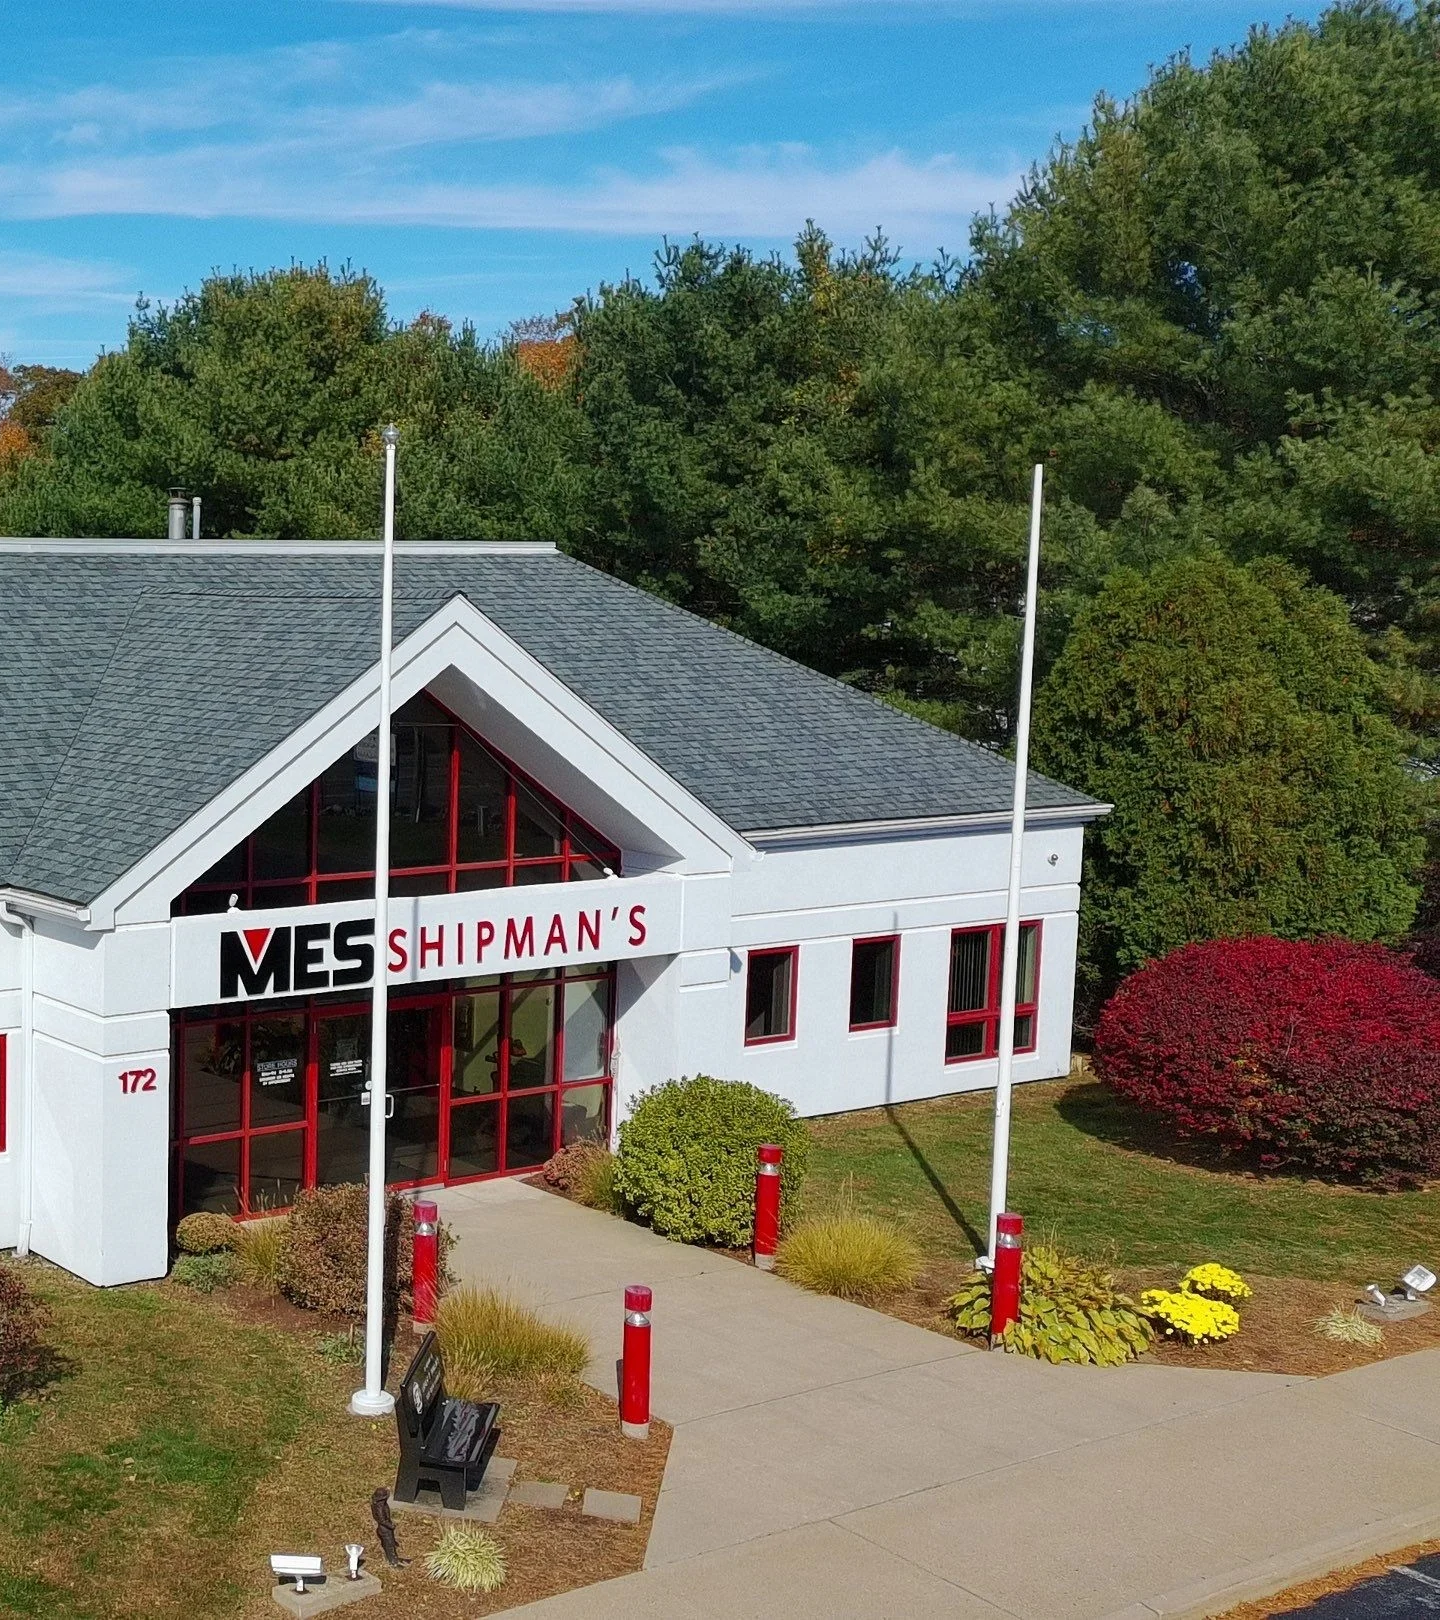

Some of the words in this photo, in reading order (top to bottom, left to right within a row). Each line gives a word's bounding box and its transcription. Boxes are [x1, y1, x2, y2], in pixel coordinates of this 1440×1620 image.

[220, 918, 376, 999] MES
[387, 905, 647, 973] SHIPMAN'S
[118, 1068, 157, 1094] 172
